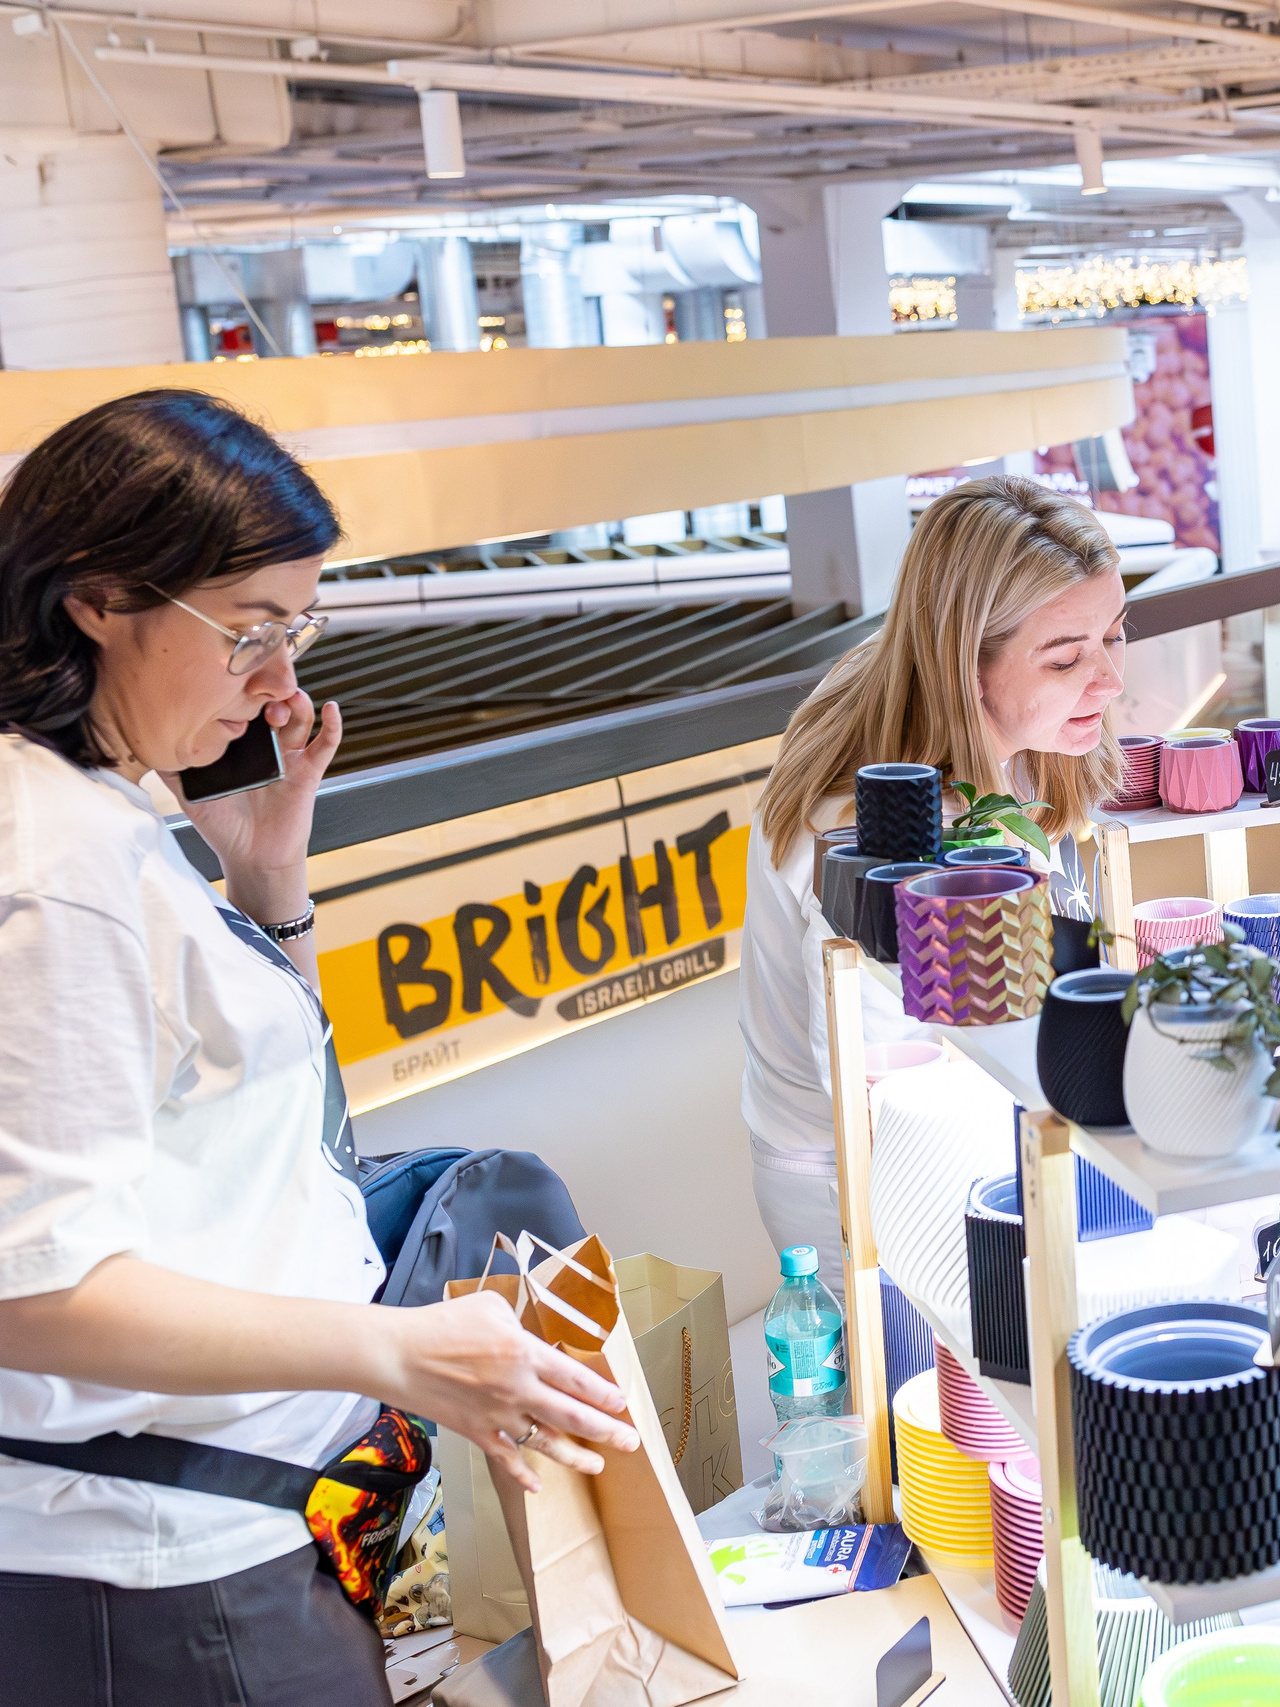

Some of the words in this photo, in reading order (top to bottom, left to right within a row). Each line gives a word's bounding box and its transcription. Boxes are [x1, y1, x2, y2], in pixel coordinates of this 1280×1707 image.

[576, 969, 656, 1017] ISRAELI
[659, 950, 717, 986] GRILL
[391, 1039, 461, 1082] БРАЙТ
[835, 1529, 857, 1562] AURA
